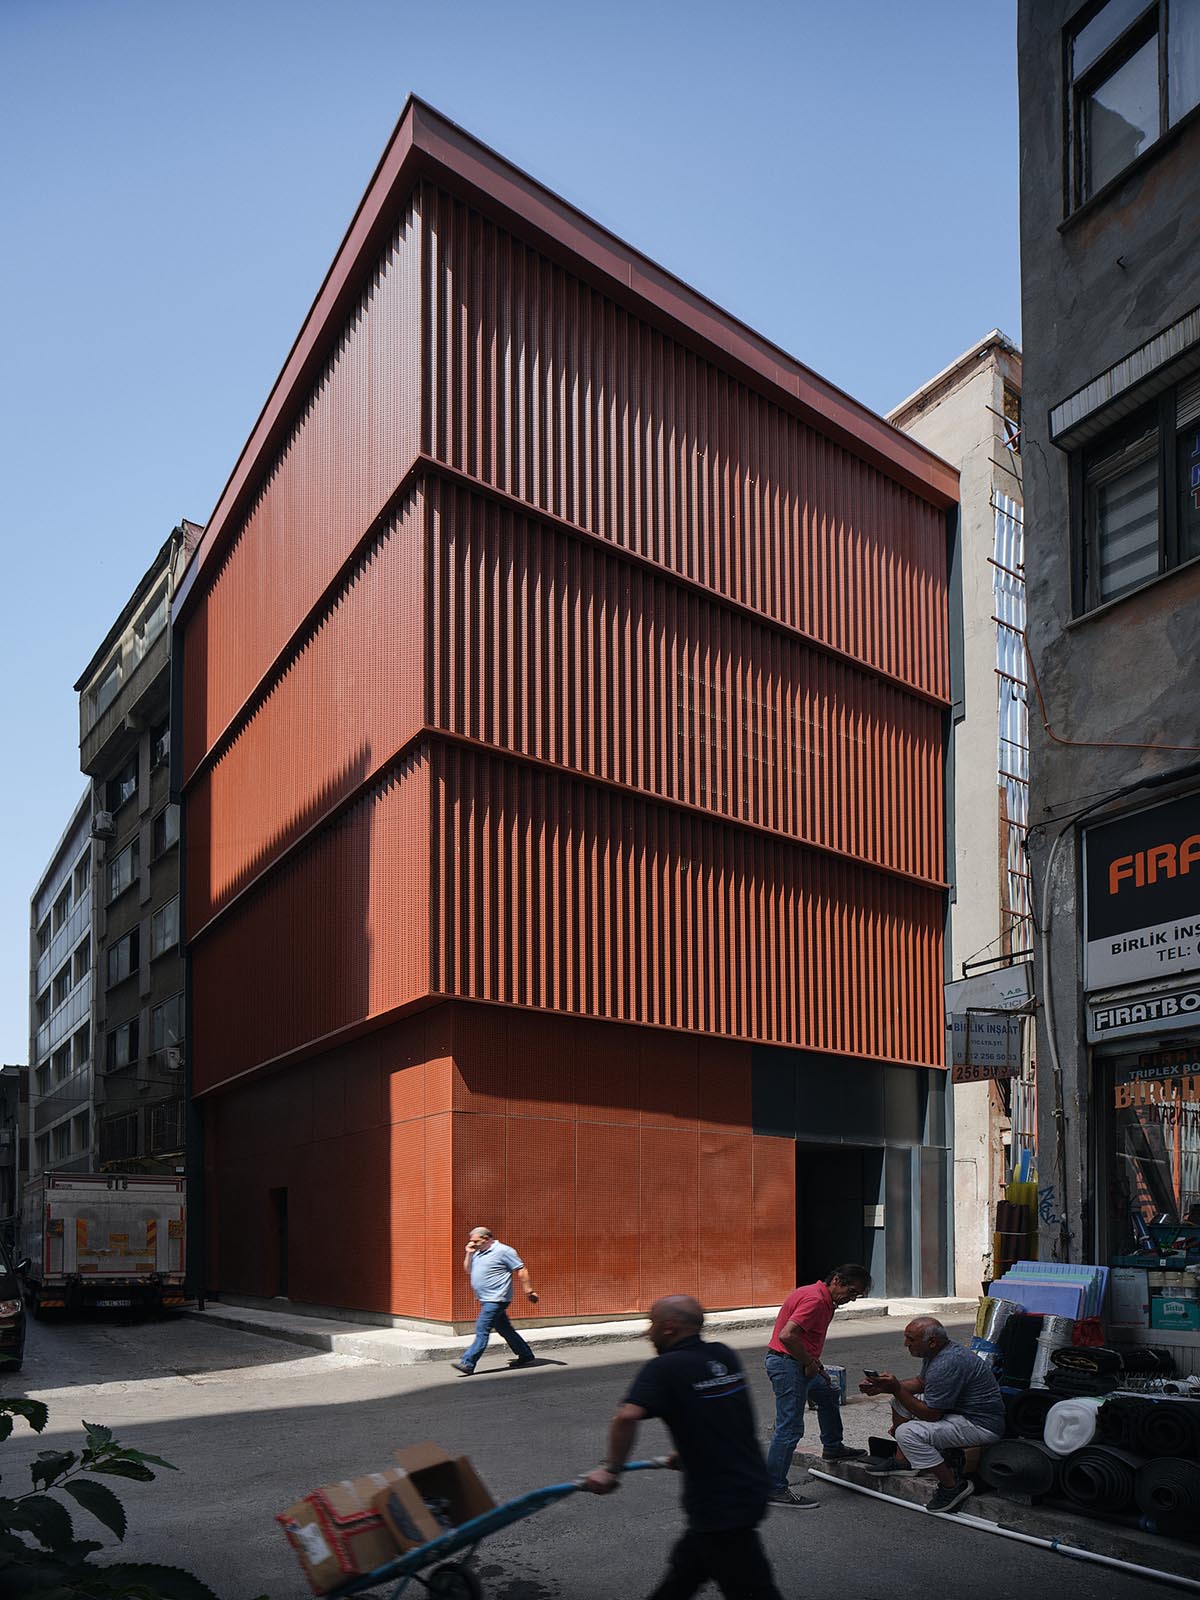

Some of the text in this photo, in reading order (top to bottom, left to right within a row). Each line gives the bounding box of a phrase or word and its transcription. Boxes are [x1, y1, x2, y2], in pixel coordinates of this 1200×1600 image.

[1111, 931, 1168, 955] BİRLİK
[1156, 945, 1191, 962] TEL:
[1096, 993, 1200, 1029] FIRATBO
[957, 1065, 979, 1081] 256
[1128, 1064, 1180, 1080] TRIPLEX
